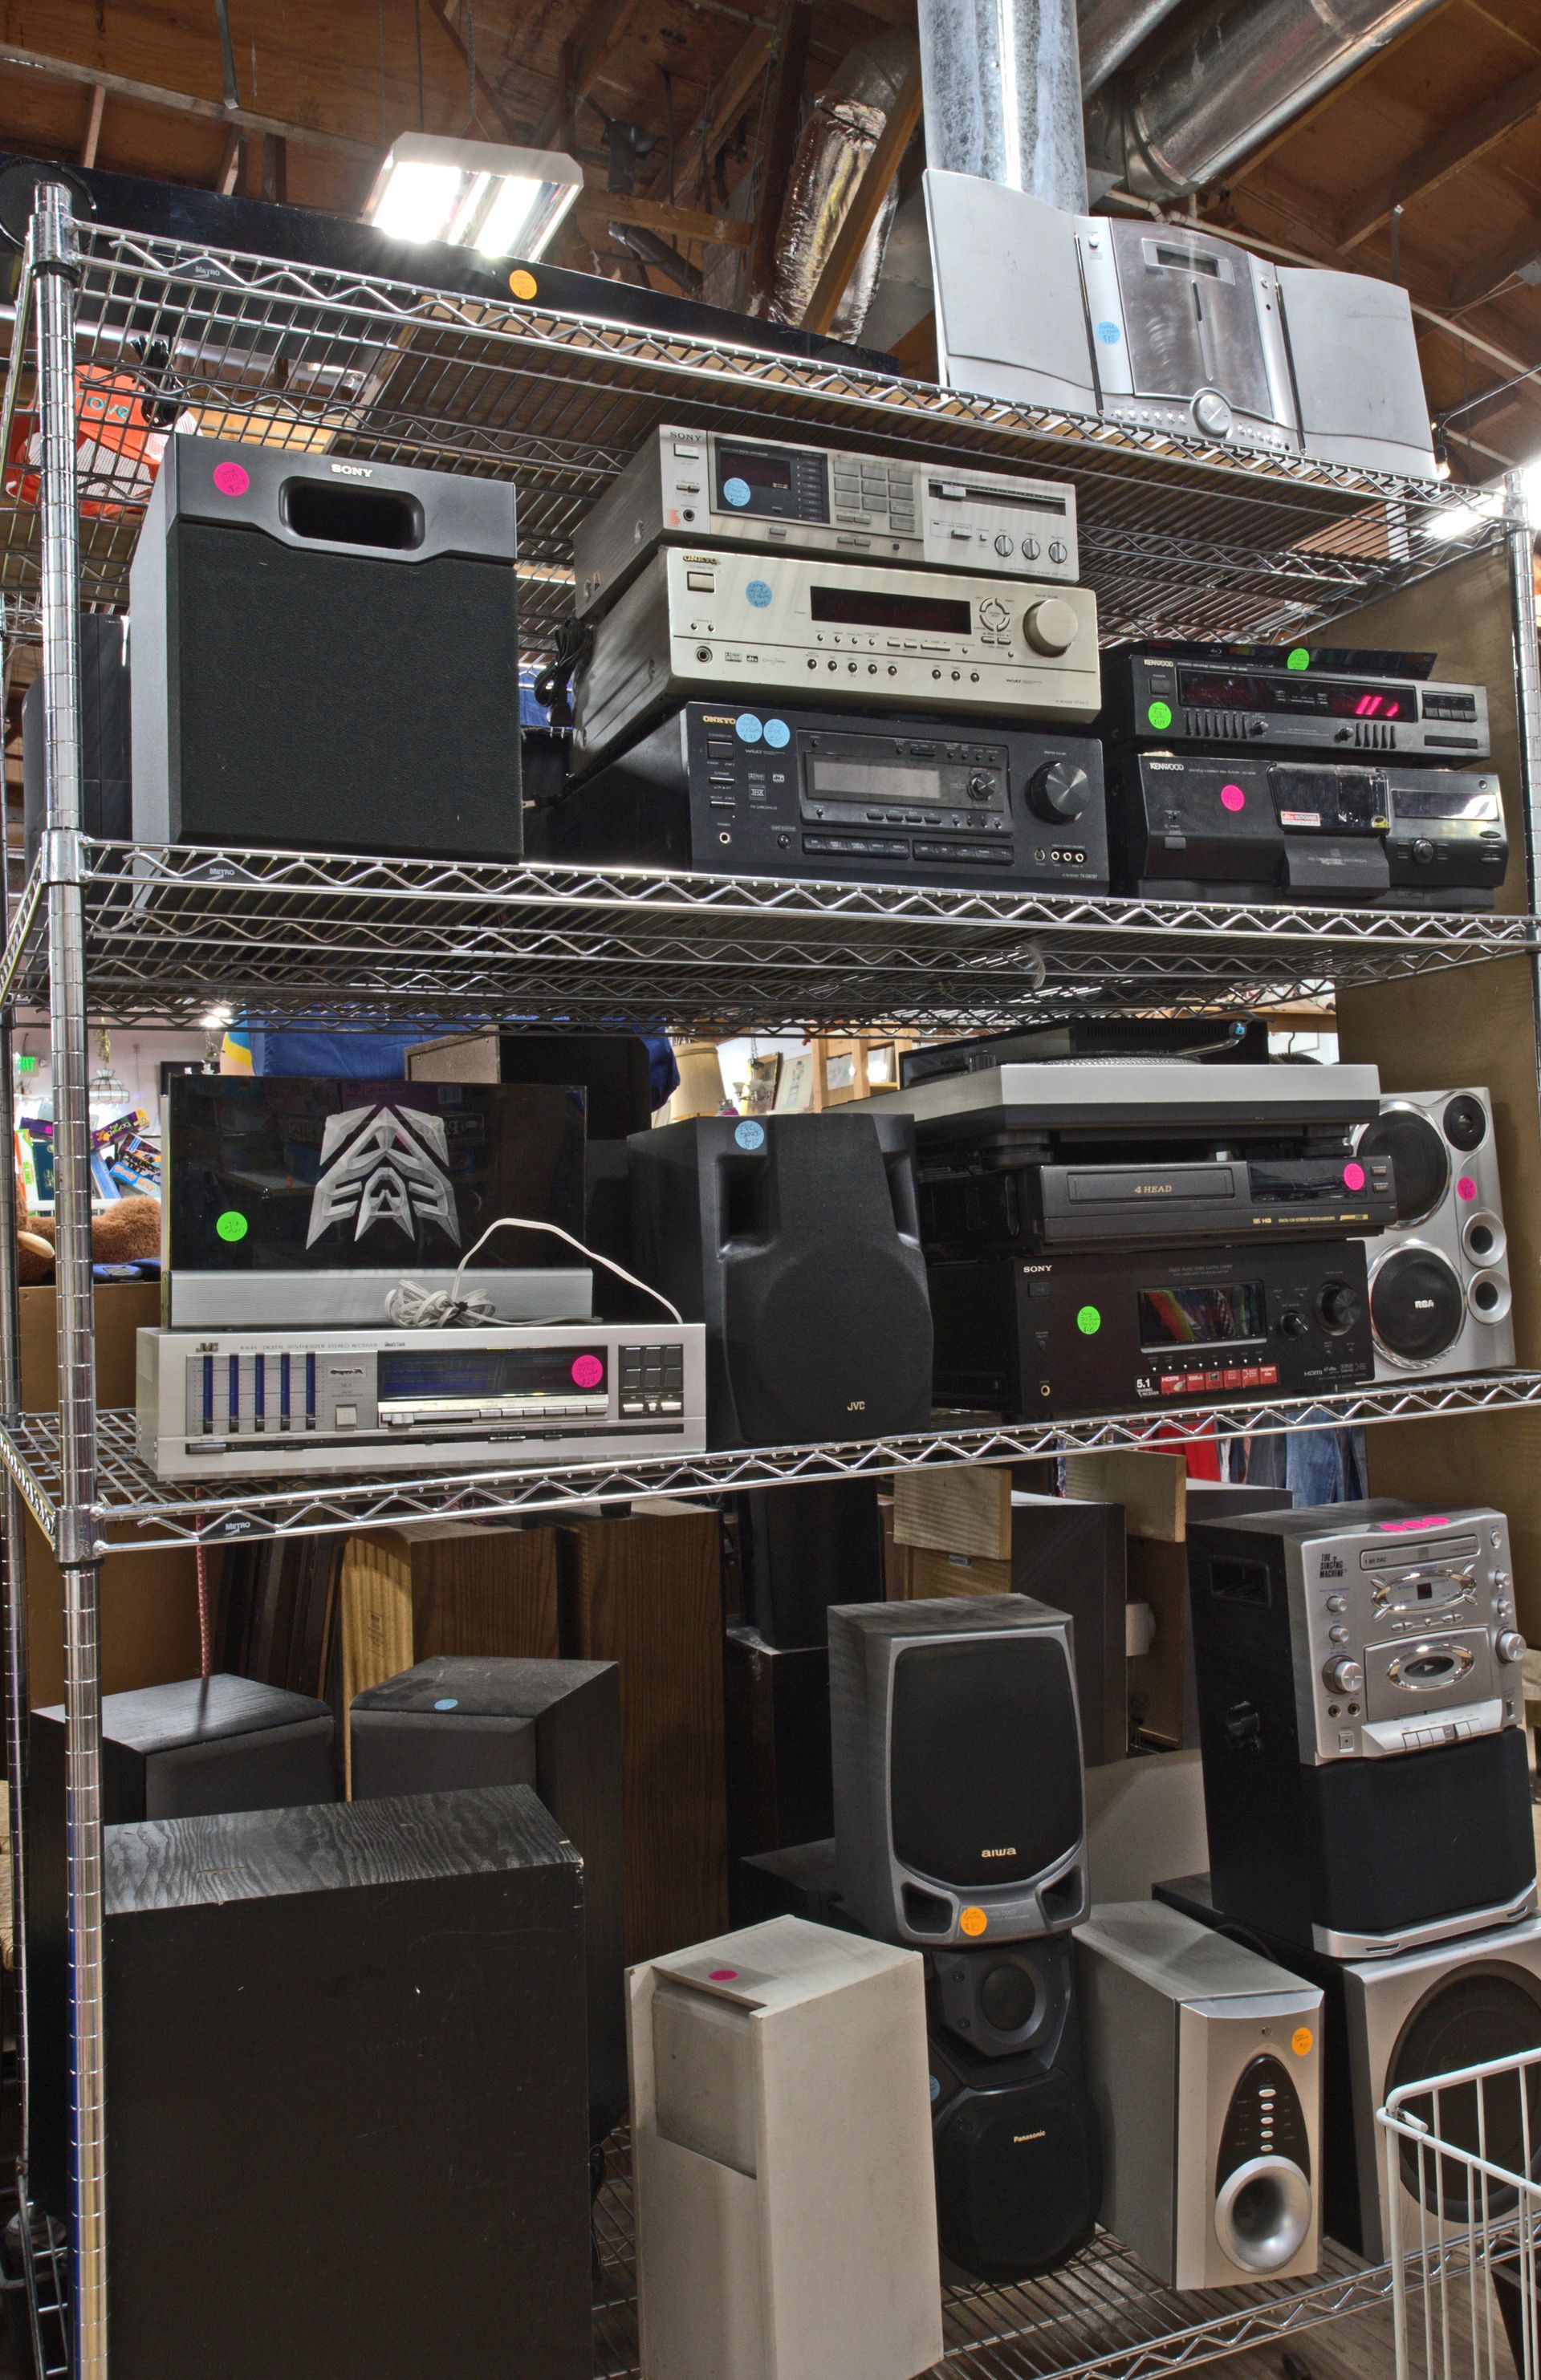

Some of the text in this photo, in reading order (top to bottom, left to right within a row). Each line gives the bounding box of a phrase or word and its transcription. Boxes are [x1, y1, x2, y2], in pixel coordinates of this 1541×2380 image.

[195, 266, 221, 278] METRO
[669, 431, 701, 441] SONY
[331, 463, 373, 477] SONY
[682, 554, 719, 565] ONKYO
[1143, 659, 1174, 668] KENWOOD
[702, 715, 736, 725] ONKYO
[1149, 762, 1185, 771] KENWOOD
[209, 867, 235, 877] METRO
[1134, 1185, 1173, 1195] 4 HEAD
[1023, 1265, 1052, 1273] SONY
[1414, 1300, 1434, 1309] RCA
[195, 1342, 219, 1353] JVC
[1304, 1369, 1323, 1377] HDMI
[1136, 1379, 1151, 1388] 5.1
[847, 1400, 865, 1411] JVC
[225, 1521, 251, 1531] METRO
[1321, 1553, 1331, 1562] THE
[1320, 1557, 1344, 1570] SINGING
[1319, 1569, 1344, 1578] MACHINE
[981, 1846, 1017, 1858] aiwa
[1014, 2129, 1046, 2143] Panasonic
